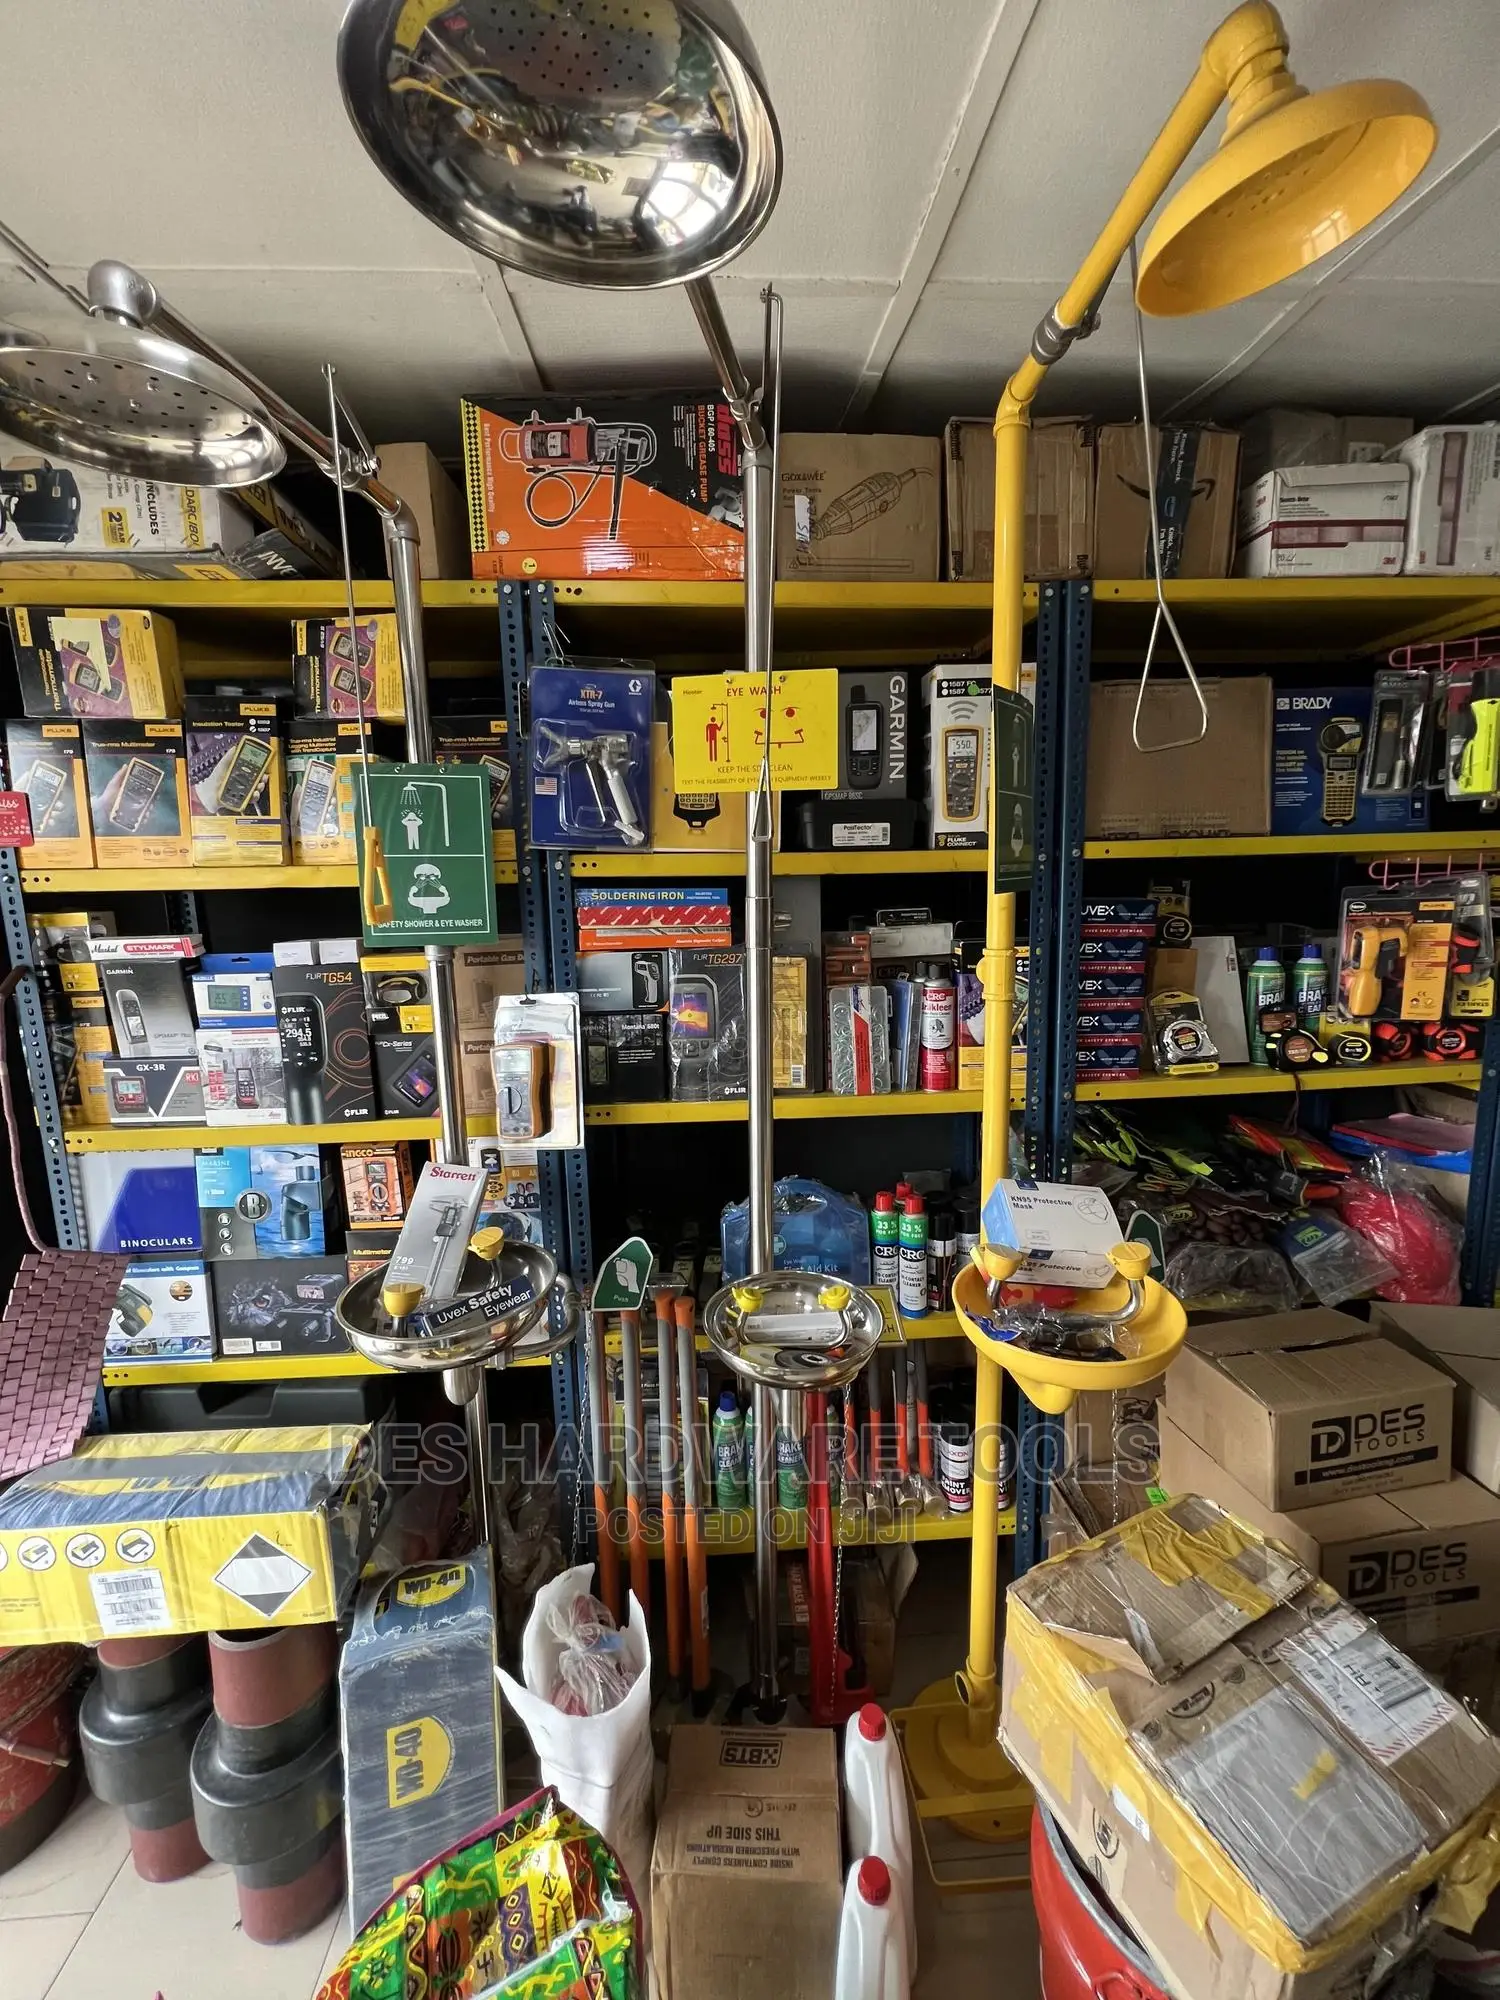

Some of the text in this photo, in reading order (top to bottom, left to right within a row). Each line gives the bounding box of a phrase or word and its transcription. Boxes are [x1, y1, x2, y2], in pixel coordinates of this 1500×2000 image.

[707, 404, 715, 421] BGP
[698, 404, 708, 503] BUCKET GREASE PUMP
[146, 481, 159, 535] INCLUDES
[107, 511, 123, 523] 2
[117, 523, 126, 544] YEAR
[44, 648, 61, 712] Thermometer
[580, 688, 603, 700] XTR-7
[726, 687, 744, 697] EYE
[587, 700, 604, 709] Spray
[1292, 696, 1333, 710] BRADY
[888, 675, 906, 780] GARMIN
[717, 763, 793, 774] KEEP THE CLEAN
[775, 775, 809, 784] EQUIPMENT
[591, 891, 684, 901] SOLDERING IRON
[404, 919, 434, 928] SHOWER
[440, 919, 453, 927] EYE
[454, 918, 483, 927] WASHER
[466, 953, 517, 964] Portable Gas
[707, 953, 742, 965] TG297
[321, 972, 353, 984] TG54
[1078, 979, 1103, 990] VEX
[926, 992, 946, 1001] CRC
[286, 1028, 312, 1038] 294.5
[136, 1063, 167, 1072] GX-3R
[429, 1166, 479, 1182] Starrett
[1033, 1197, 1073, 1206] Protective
[877, 1221, 889, 1230] 33
[901, 1223, 912, 1232] 33
[120, 1237, 194, 1248] BINOCULARS
[353, 1248, 392, 1256] Multimeter
[900, 1247, 926, 1260] CRC
[394, 1256, 414, 1265] 799
[806, 1264, 839, 1272] Aid Kit
[1038, 1262, 1082, 1272] Protective
[437, 1284, 513, 1325] Uvex Safety
[483, 1289, 532, 1318] Eyewear
[1354, 1403, 1426, 1440] DES
[1354, 1428, 1425, 1453] TOOLS
[1390, 1541, 1468, 1575] DES
[404, 1570, 461, 1596] WD-40
[1390, 1567, 1467, 1591] TOOLS
[394, 1726, 426, 1801] WD-40
[706, 1825, 781, 1841] THIS SIDE UP
[779, 1847, 801, 1856] WITH
[692, 1855, 794, 1869] INSIDE CONTAINERS COMPLY
